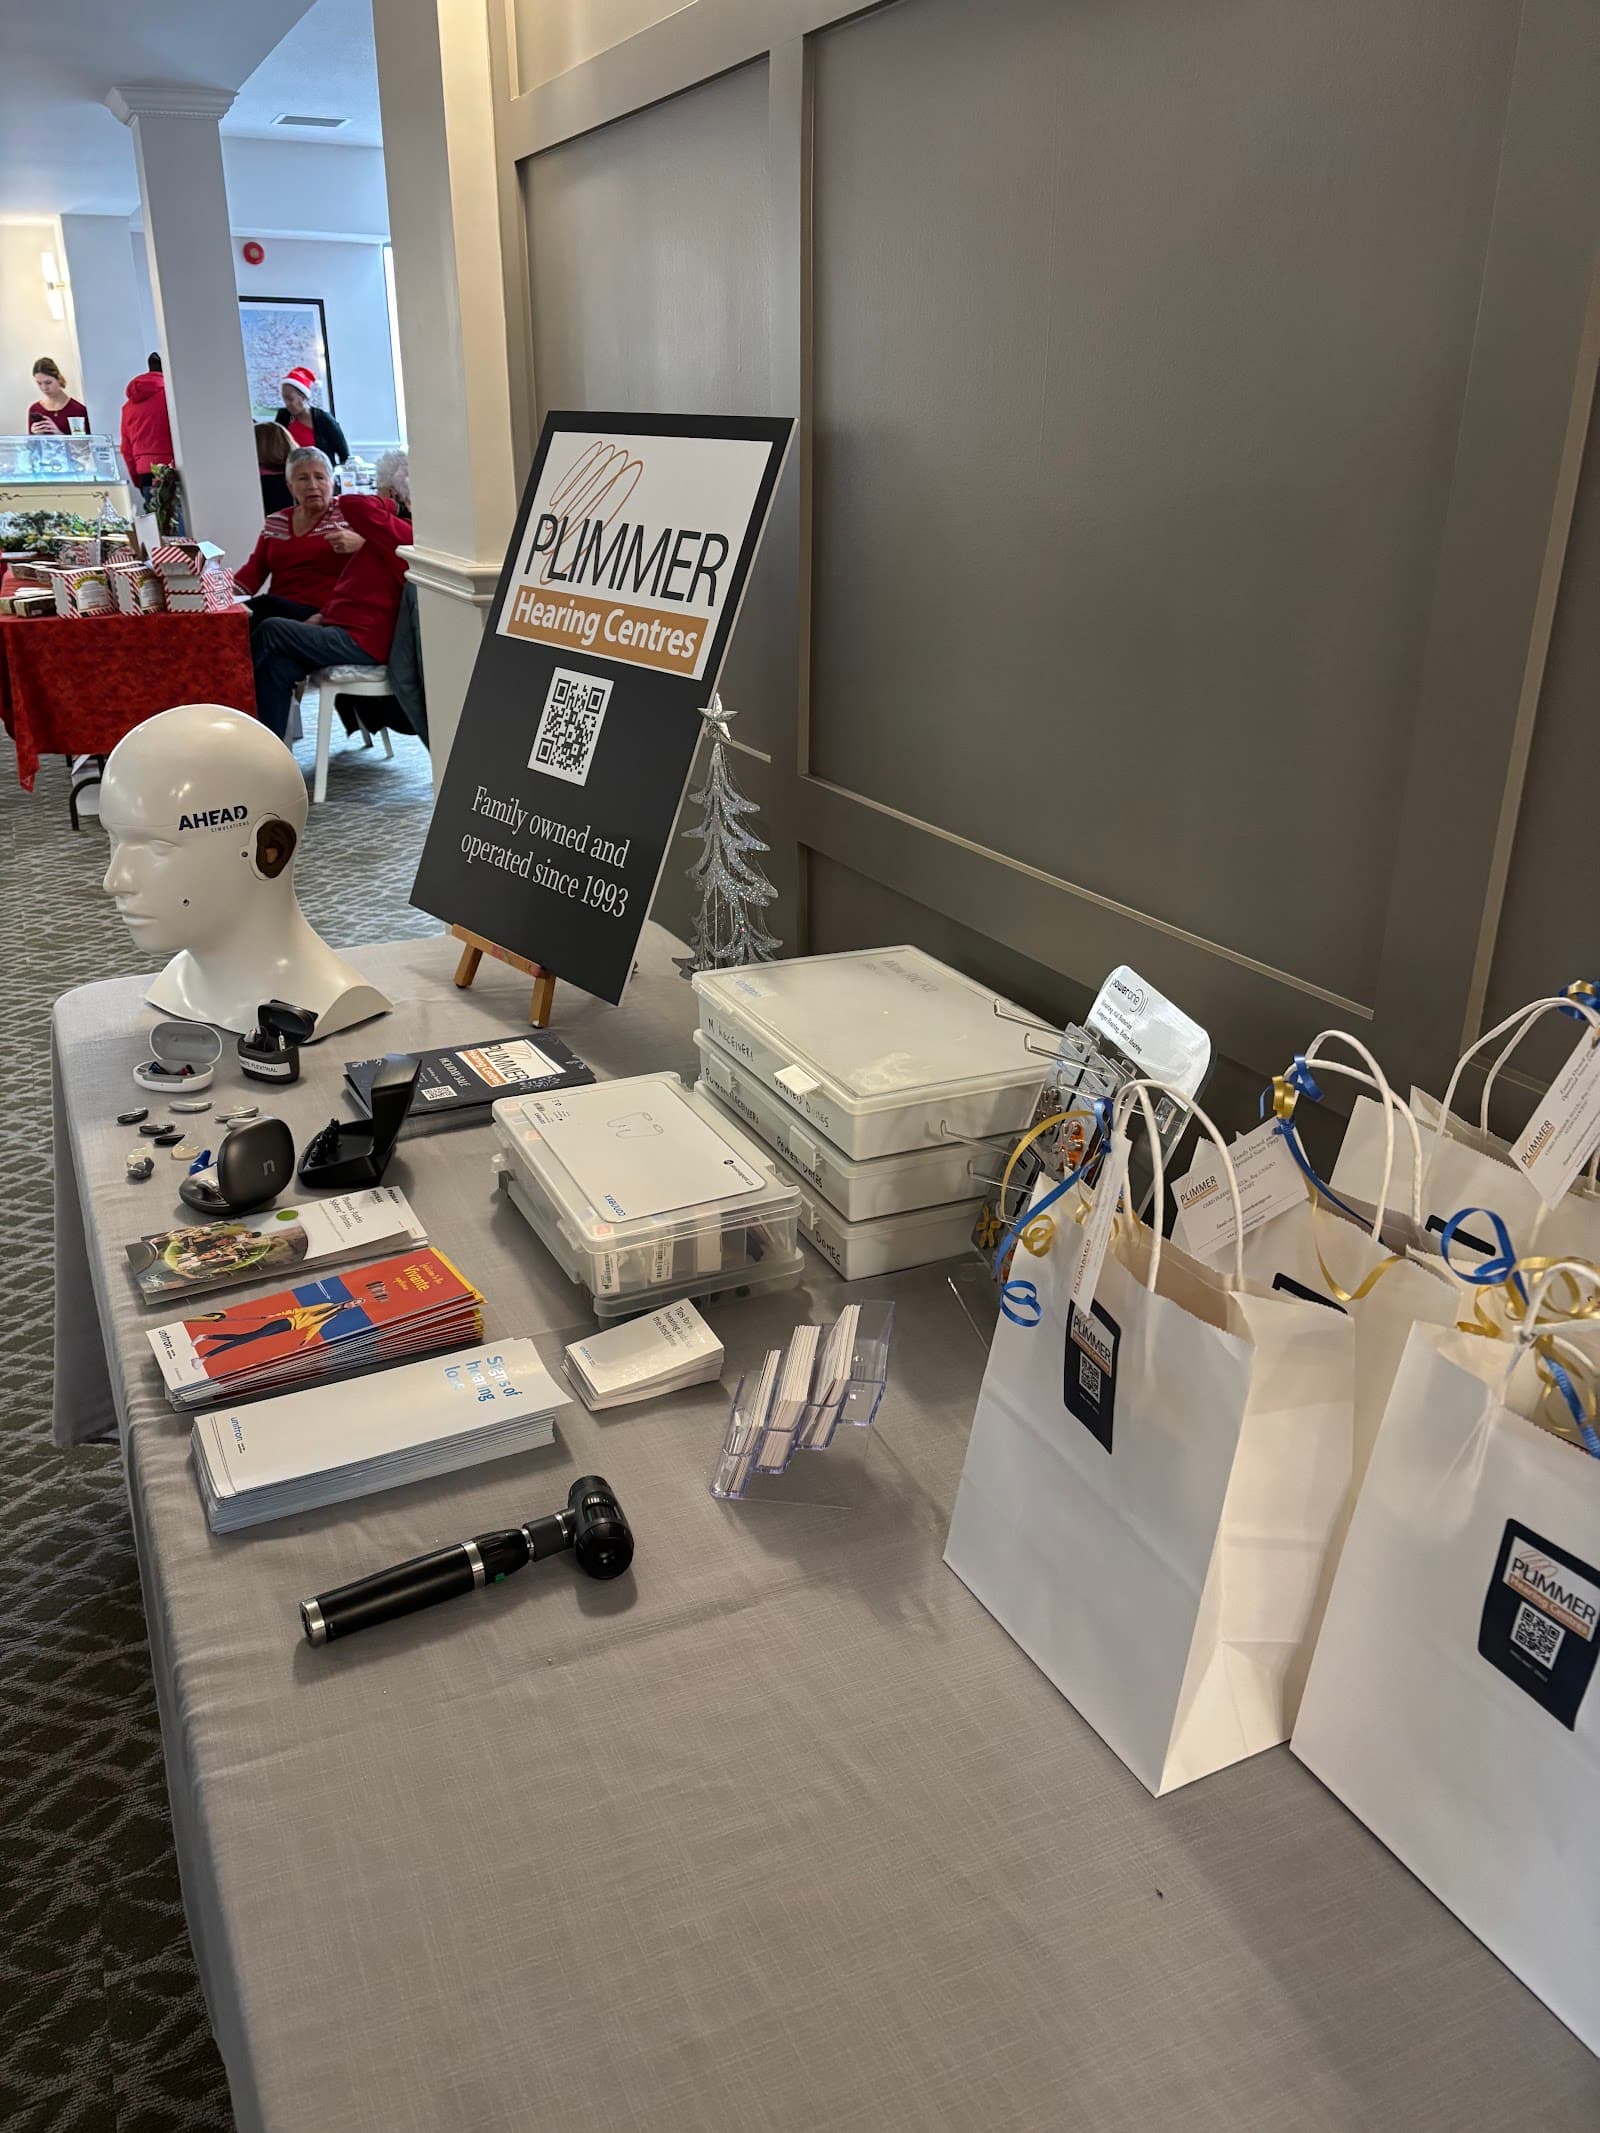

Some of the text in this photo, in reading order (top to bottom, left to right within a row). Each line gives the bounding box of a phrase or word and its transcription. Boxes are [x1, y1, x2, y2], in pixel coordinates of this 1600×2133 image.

[524, 513, 729, 607] PLIMMER
[514, 591, 698, 659] Hearing Centres
[178, 805, 248, 831] AHEAD
[472, 785, 630, 869] Family owned and
[461, 833, 628, 918] operated since 1993
[484, 1045, 530, 1082] PLIMMER
[1520, 1119, 1552, 1165] PLIMMER
[1180, 1175, 1217, 1203] PLIMMER
[403, 1264, 430, 1292] Vivante
[1073, 1314, 1111, 1363] PLIMMER
[444, 1365, 464, 1390] loss
[465, 1360, 496, 1402] hearing
[486, 1355, 523, 1397] Signs of
[231, 1417, 243, 1442] unitron
[1511, 1557, 1596, 1624] PLIMMER
